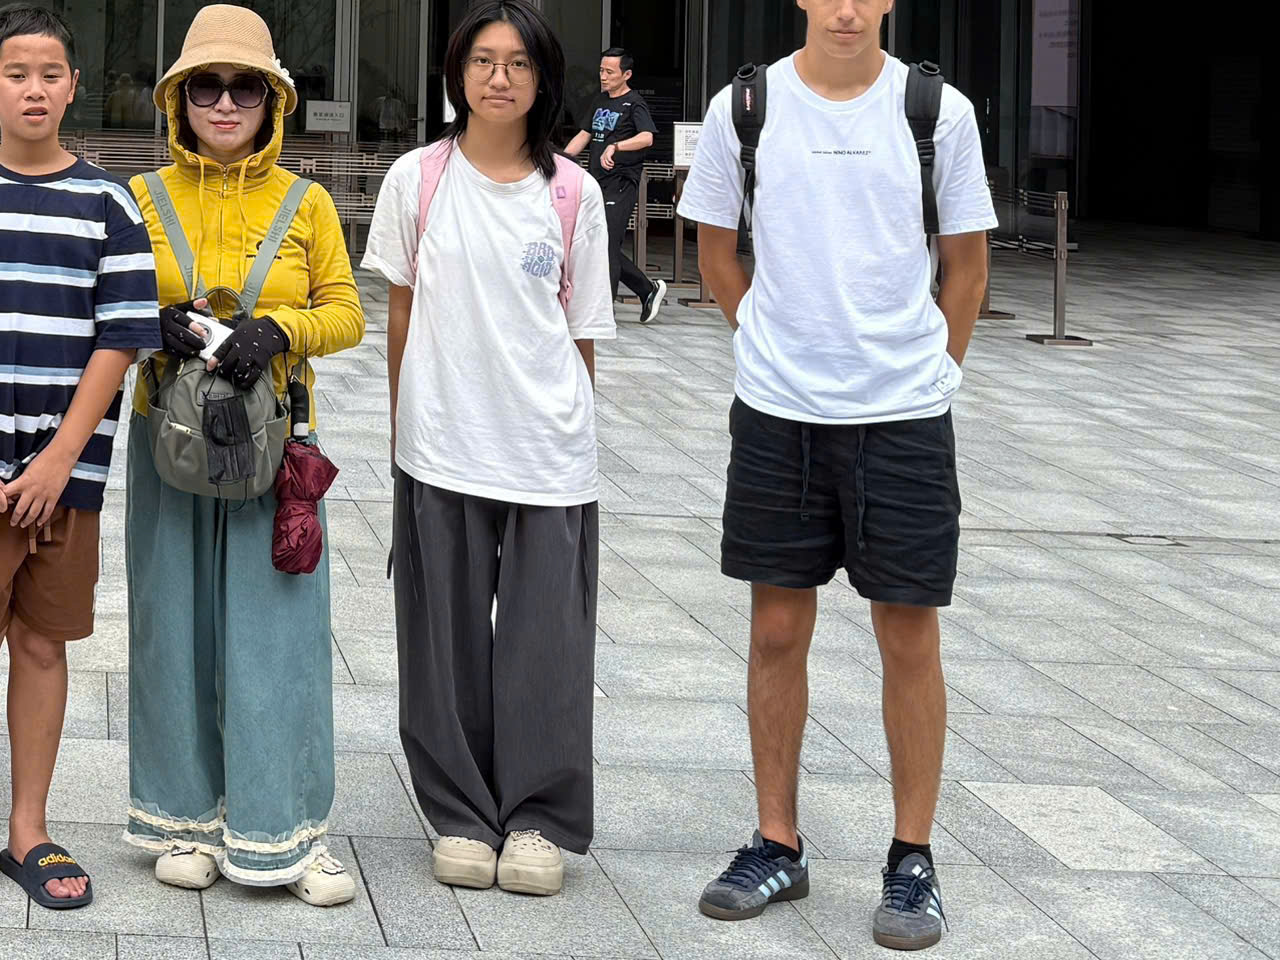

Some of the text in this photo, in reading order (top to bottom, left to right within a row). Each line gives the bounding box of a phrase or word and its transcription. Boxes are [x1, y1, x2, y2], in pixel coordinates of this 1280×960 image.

[154, 190, 176, 227] JIELSHI
[268, 204, 292, 243] JIELSHI
[37, 852, 76, 867] adidas
